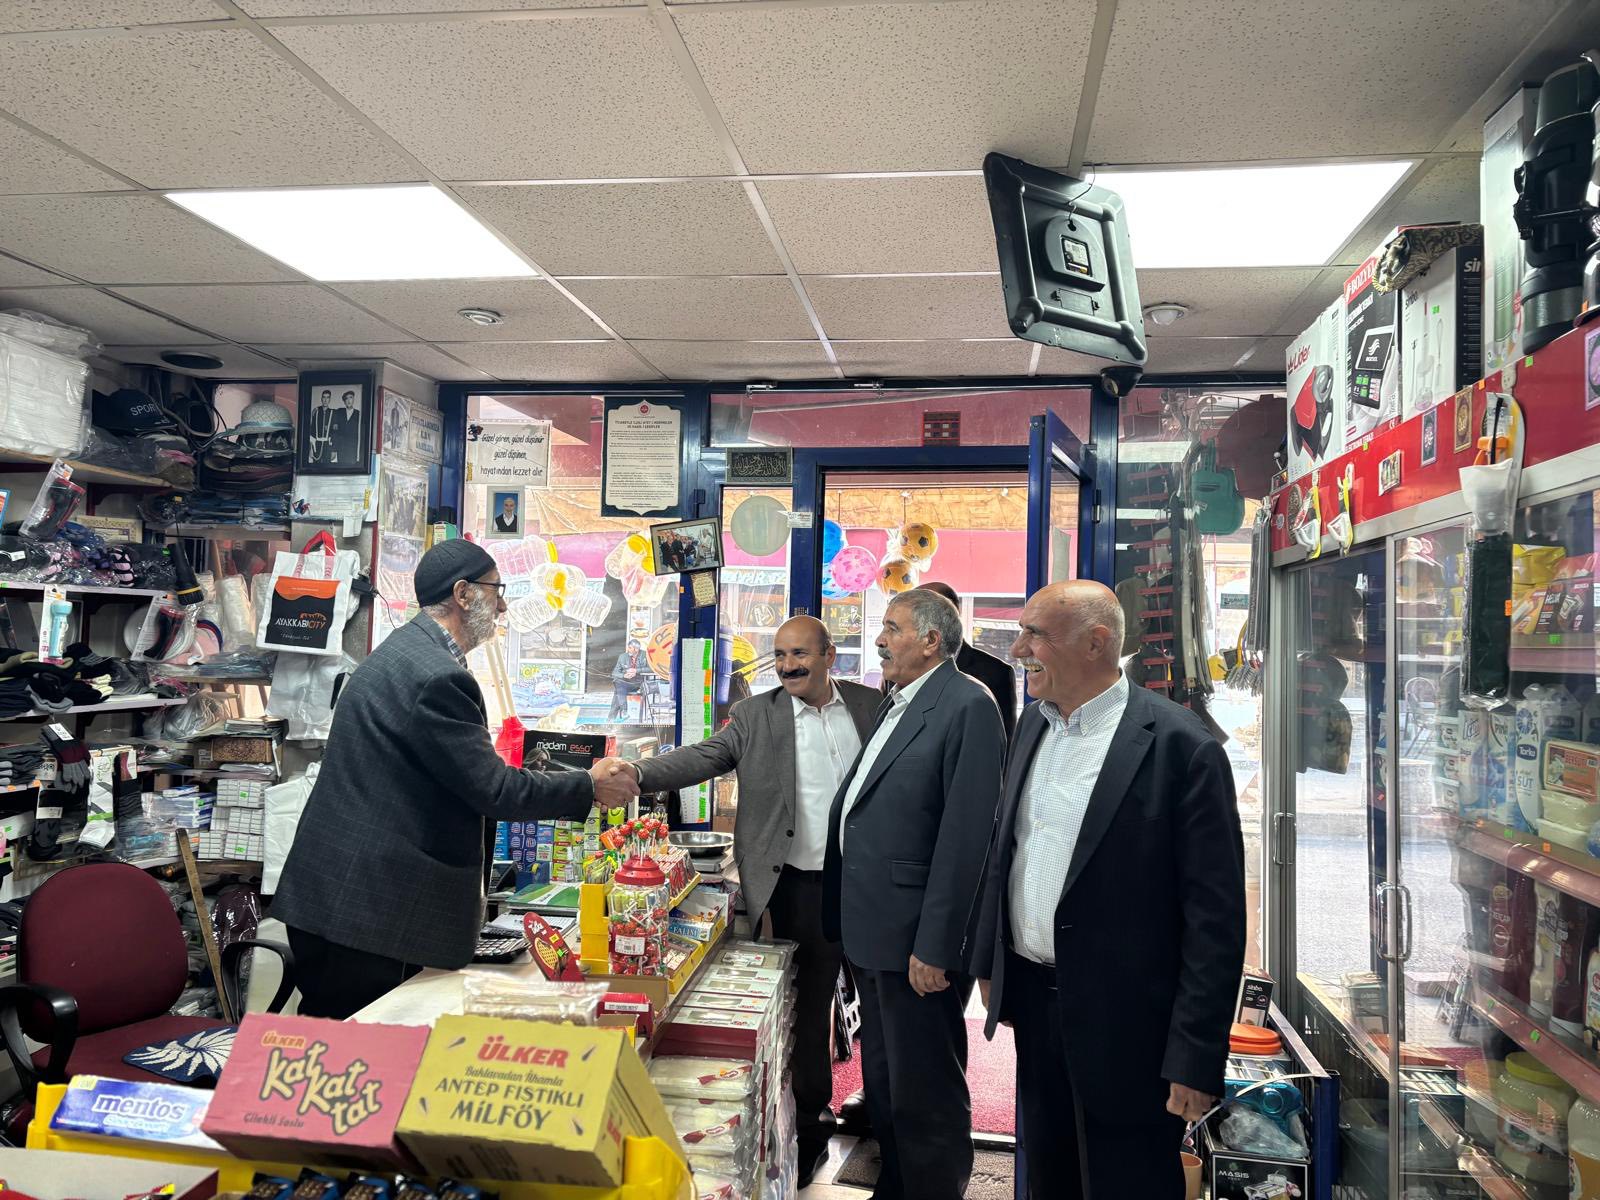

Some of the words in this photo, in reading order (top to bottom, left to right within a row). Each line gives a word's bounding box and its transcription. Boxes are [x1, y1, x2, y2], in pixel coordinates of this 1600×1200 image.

[511, 434, 525, 446] güzel
[493, 449, 508, 461] güzel
[513, 466, 531, 476] lezzet
[536, 740, 567, 751] madam
[262, 1031, 305, 1048] ÜLKER
[478, 1035, 570, 1069] ÜLKER
[465, 1065, 523, 1083] Baklavadan
[435, 1077, 500, 1098] ANTEP
[503, 1084, 585, 1109] FISTIKLI
[94, 1095, 186, 1121] mentos
[450, 1099, 552, 1131] MİLFÖY
